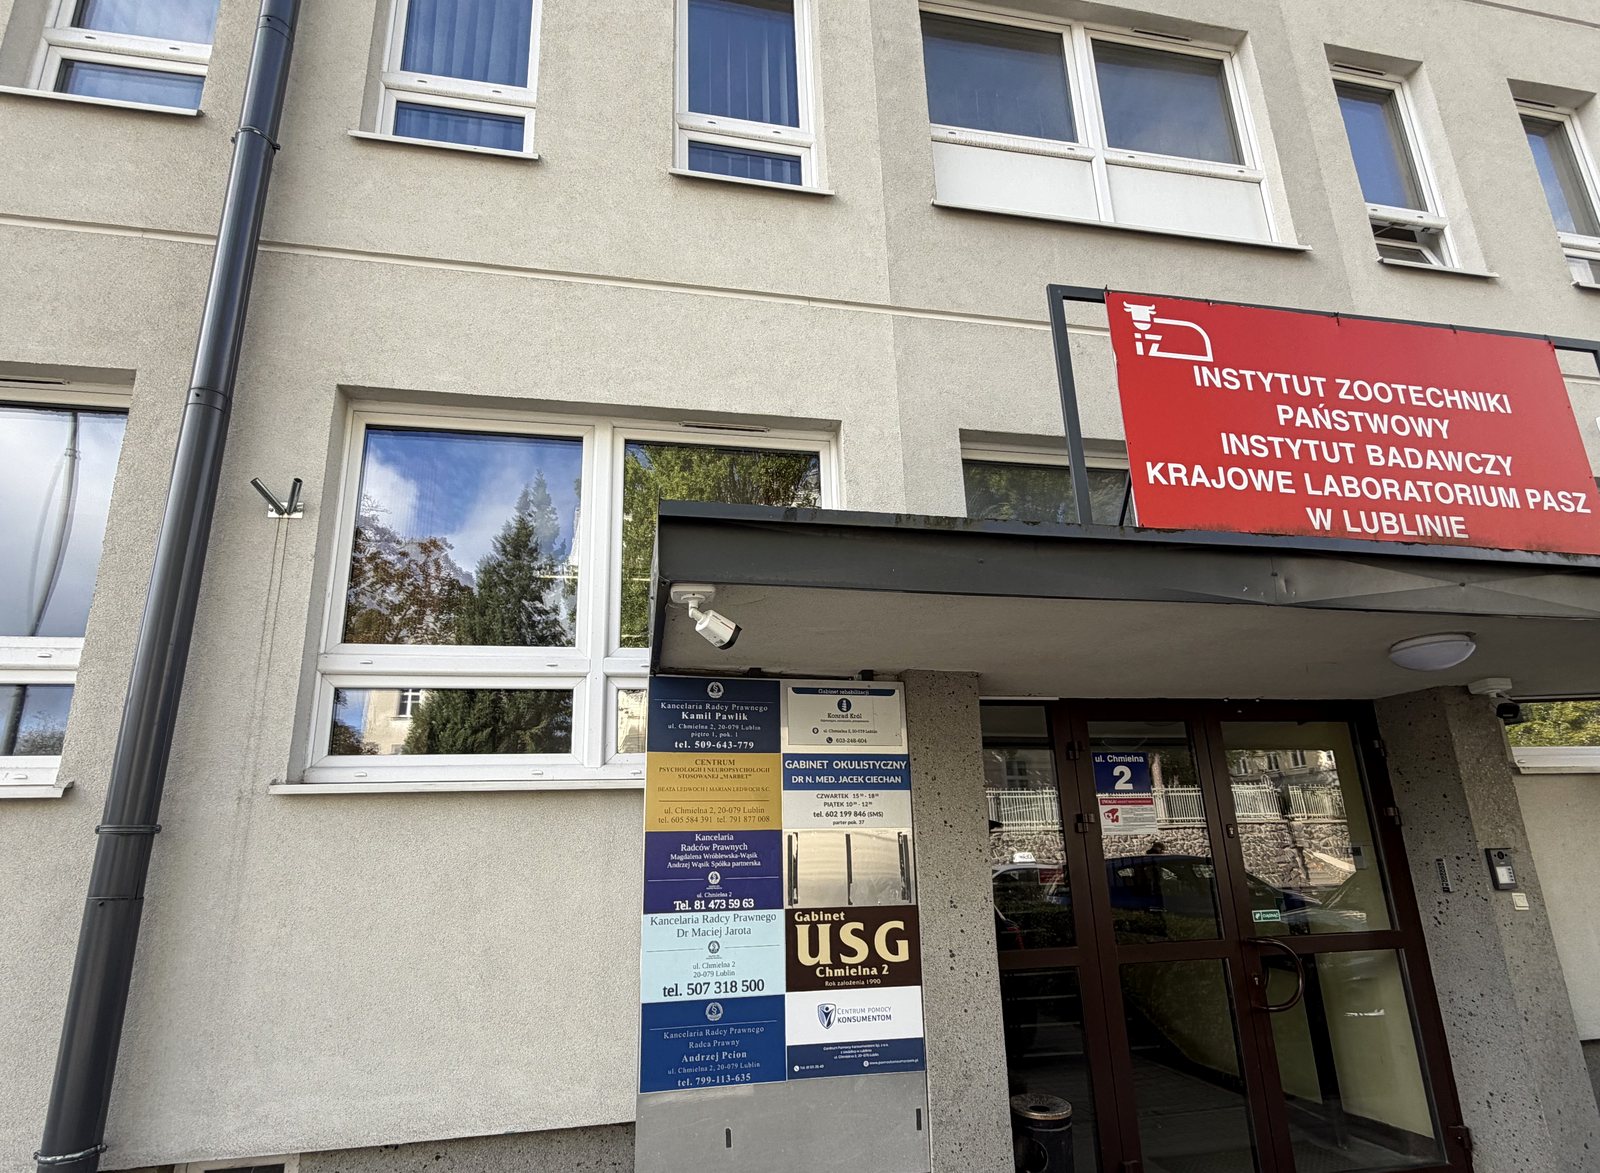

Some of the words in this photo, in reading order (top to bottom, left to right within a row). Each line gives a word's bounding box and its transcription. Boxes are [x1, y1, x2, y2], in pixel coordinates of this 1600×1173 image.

[1193, 365, 1326, 398] INSTYTUT
[1335, 378, 1512, 414] ZOOTECHNIKI
[1277, 403, 1449, 440] PAŃSTWOWY
[1221, 432, 1355, 465] INSTYTUT
[1367, 444, 1512, 477] BADAWCZY
[1146, 461, 1295, 495] KRAJOWE
[1304, 472, 1520, 510] LABORATORIUM
[1525, 488, 1591, 514] PASZ
[1306, 506, 1333, 531] W
[1343, 509, 1469, 539] LUBLINIE
[660, 702, 703, 710] Kancelaria
[705, 703, 729, 712] Radcy
[731, 704, 768, 712] Prawnego
[681, 711, 712, 720] Kamil
[715, 712, 748, 720] Pawlik
[674, 741, 691, 749] tel.
[694, 741, 754, 749] 509-643-779
[1094, 755, 1105, 763] ul.
[1107, 754, 1144, 763] Chmielna
[785, 760, 829, 769] GABINET
[832, 760, 907, 770] OKULISTYCZNY
[838, 776, 865, 784] JACEK
[865, 776, 902, 784] CIECHAN
[1113, 765, 1134, 790] 2
[674, 806, 708, 814] Chmielna
[717, 806, 741, 814] 20-079
[813, 810, 824, 818] tel.
[825, 810, 838, 818] 602
[839, 810, 852, 818] 199
[853, 810, 867, 818] 846
[757, 815, 770, 823] 008
[695, 833, 734, 841] Kancelaria
[680, 843, 711, 852] Radców
[712, 843, 748, 852] Prawnych
[670, 853, 702, 861] Magdalena
[703, 852, 758, 861] Wróblewska-Wąsik
[691, 861, 710, 869] Wąsik
[711, 860, 731, 868] Spółka
[732, 860, 761, 868] partnerska
[674, 900, 691, 911] Tel.
[694, 899, 706, 910] 81
[708, 899, 726, 910] 473
[728, 898, 740, 909] 59
[742, 898, 754, 908] 63
[650, 915, 699, 926] Kancelaria
[702, 914, 730, 925] Radcy
[733, 913, 777, 923] Prawnego
[794, 911, 846, 922] Gabinet
[676, 928, 689, 938] Dr
[692, 927, 722, 938] Maciej
[725, 926, 752, 936] Jarota
[795, 920, 910, 966] USG
[692, 962, 700, 970] ul.
[701, 961, 731, 969] Chmielna
[815, 965, 878, 977] Chmielna
[881, 964, 889, 975] 2
[693, 970, 715, 978] 20-079
[663, 984, 683, 997] tel.
[687, 982, 711, 996] 507
[714, 981, 738, 994] 318
[741, 979, 765, 992] 500
[836, 1007, 866, 1015] CENTRUM
[837, 1014, 892, 1024] KONSUMENTOM
[663, 1030, 704, 1039] Kancelaria
[705, 1029, 727, 1037] Radcy
[729, 1026, 765, 1035] Prawnego
[688, 1041, 711, 1049] Radca
[681, 1052, 719, 1063] Andrzej
[678, 1066, 708, 1074] Chmielna
[717, 1063, 739, 1071] 20-079
[740, 1061, 761, 1069] Lublin
[677, 1078, 693, 1087] tel.
[695, 1072, 751, 1085] 799-113-635
